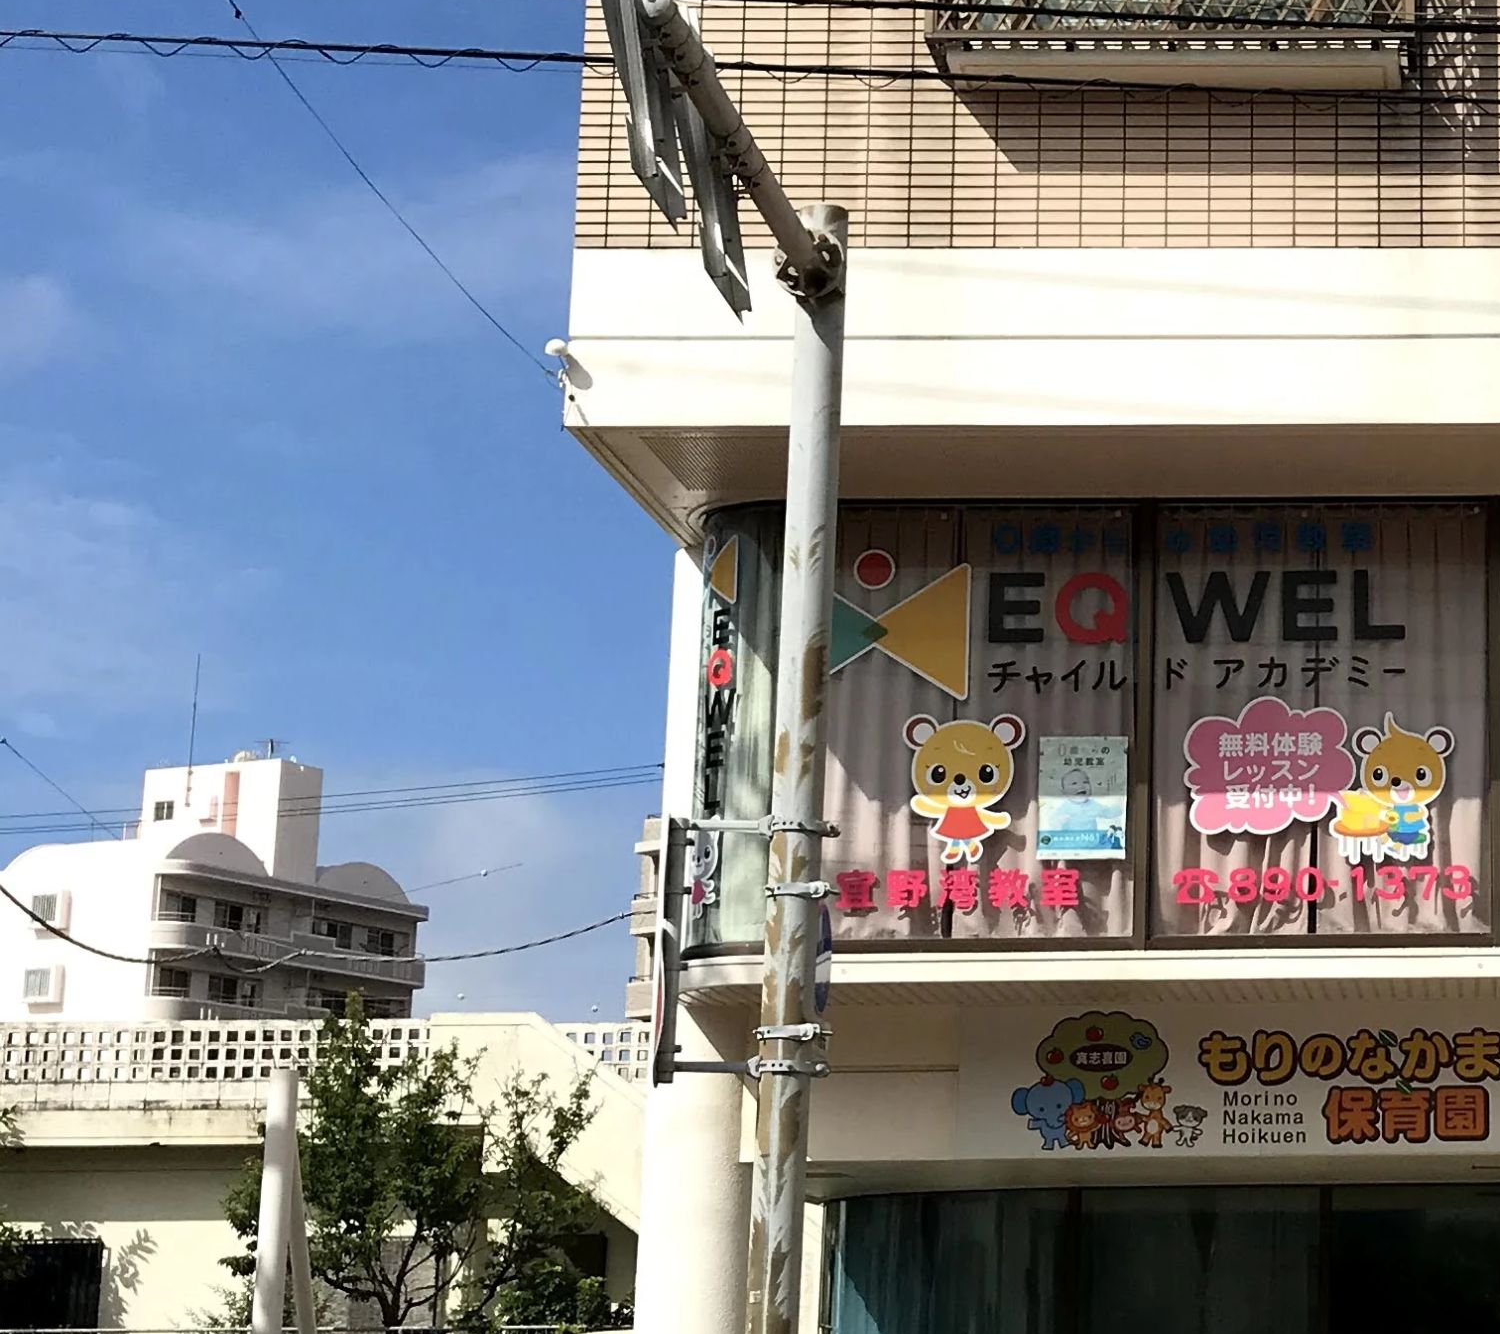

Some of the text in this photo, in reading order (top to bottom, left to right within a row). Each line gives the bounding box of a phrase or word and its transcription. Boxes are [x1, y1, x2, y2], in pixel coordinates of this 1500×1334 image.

[1218, 731, 1323, 758] 無料体験
[1222, 760, 1320, 783] レッスン
[834, 868, 1081, 910] 宜野湾教室
[1223, 1110, 1304, 1125] Nakama
[1321, 1085, 1490, 1145] 保育園
[1223, 1128, 1307, 1144] Hoikuen
